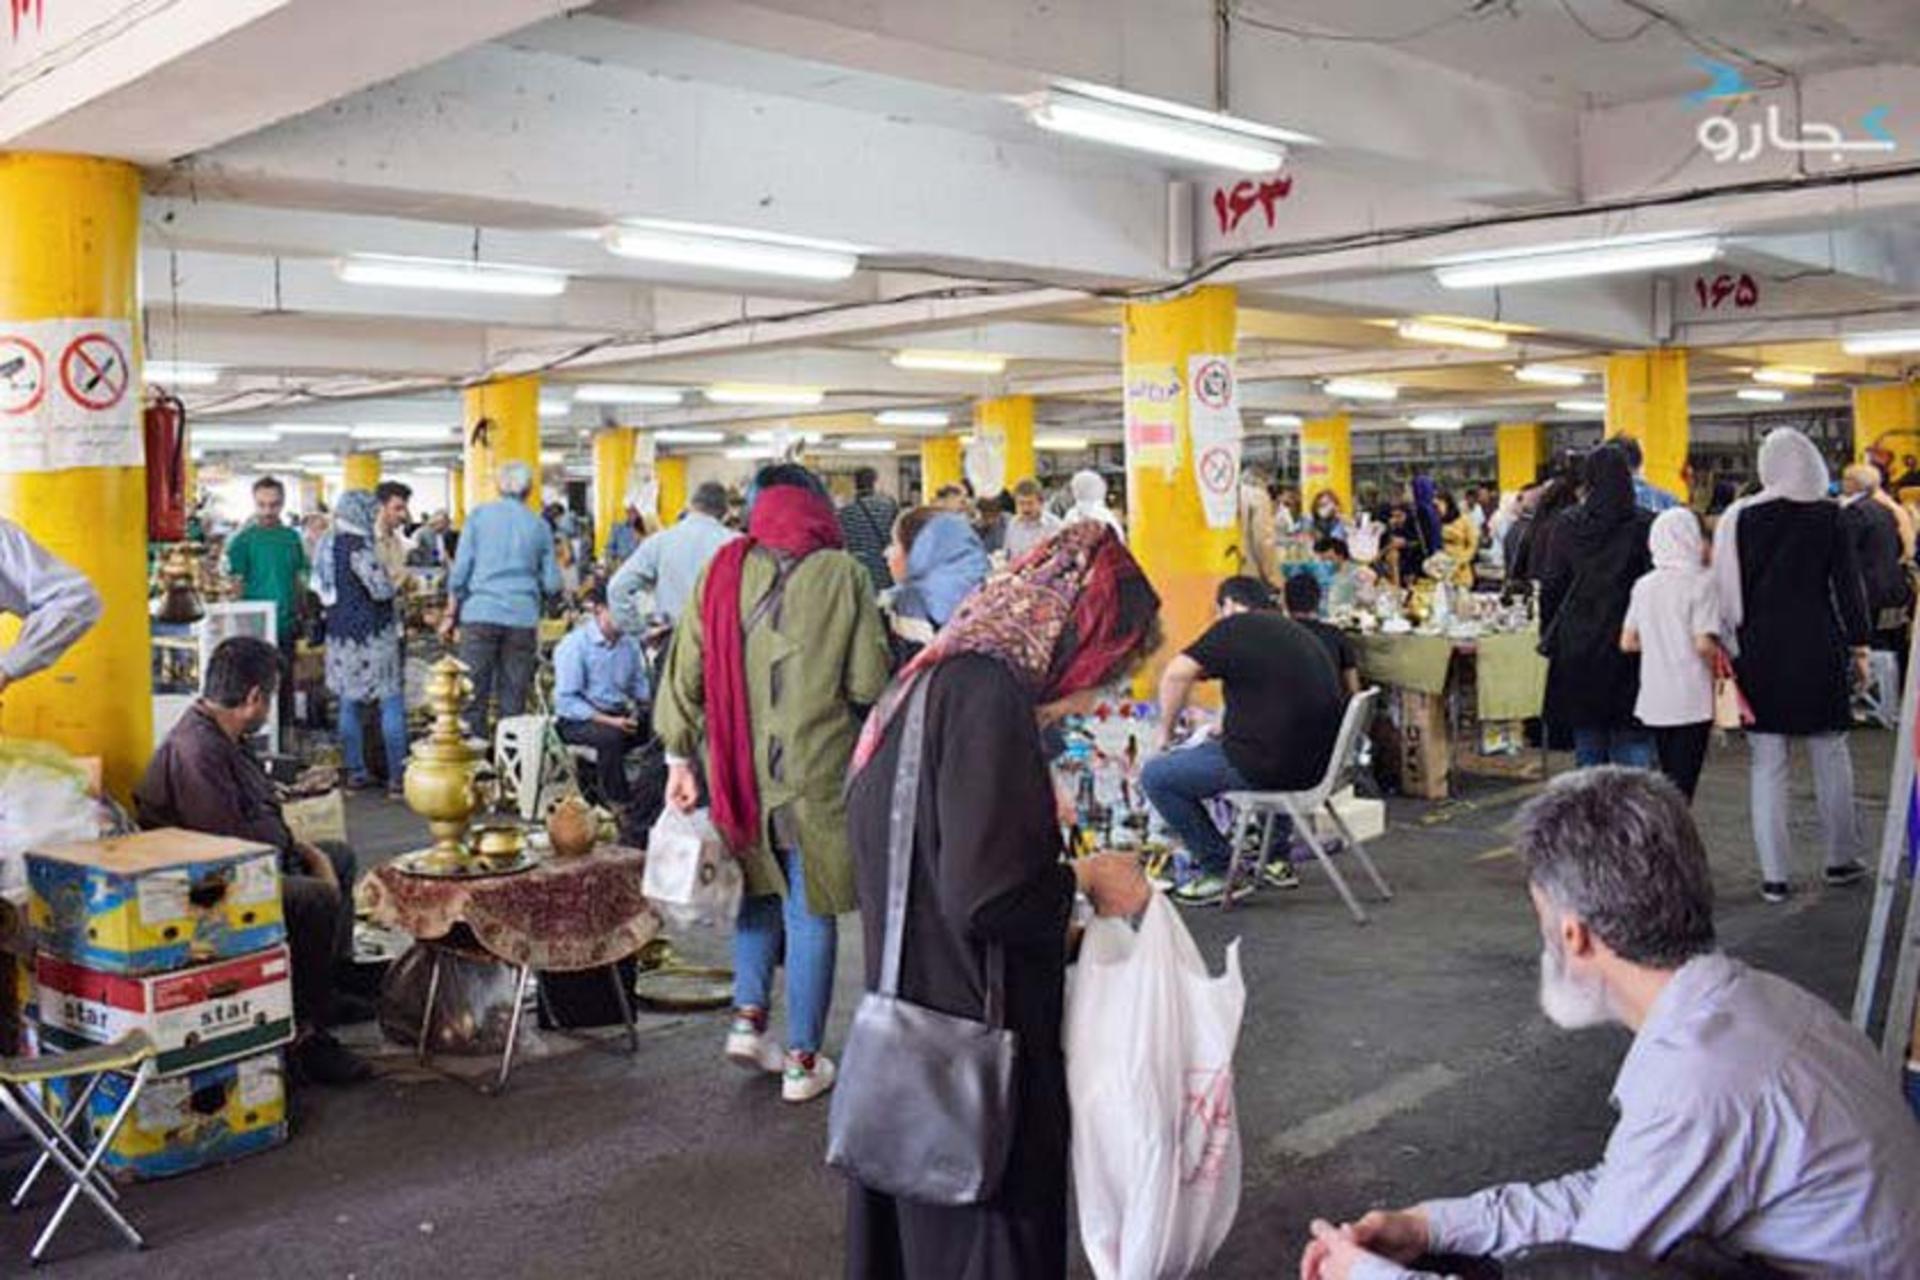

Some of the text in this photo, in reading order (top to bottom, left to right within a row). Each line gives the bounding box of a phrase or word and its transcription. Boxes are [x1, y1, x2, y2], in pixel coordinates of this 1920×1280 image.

[1213, 176, 1293, 235] ۱۶۳
[1695, 273, 1758, 309] ۱۶۵
[200, 999, 252, 1027] star
